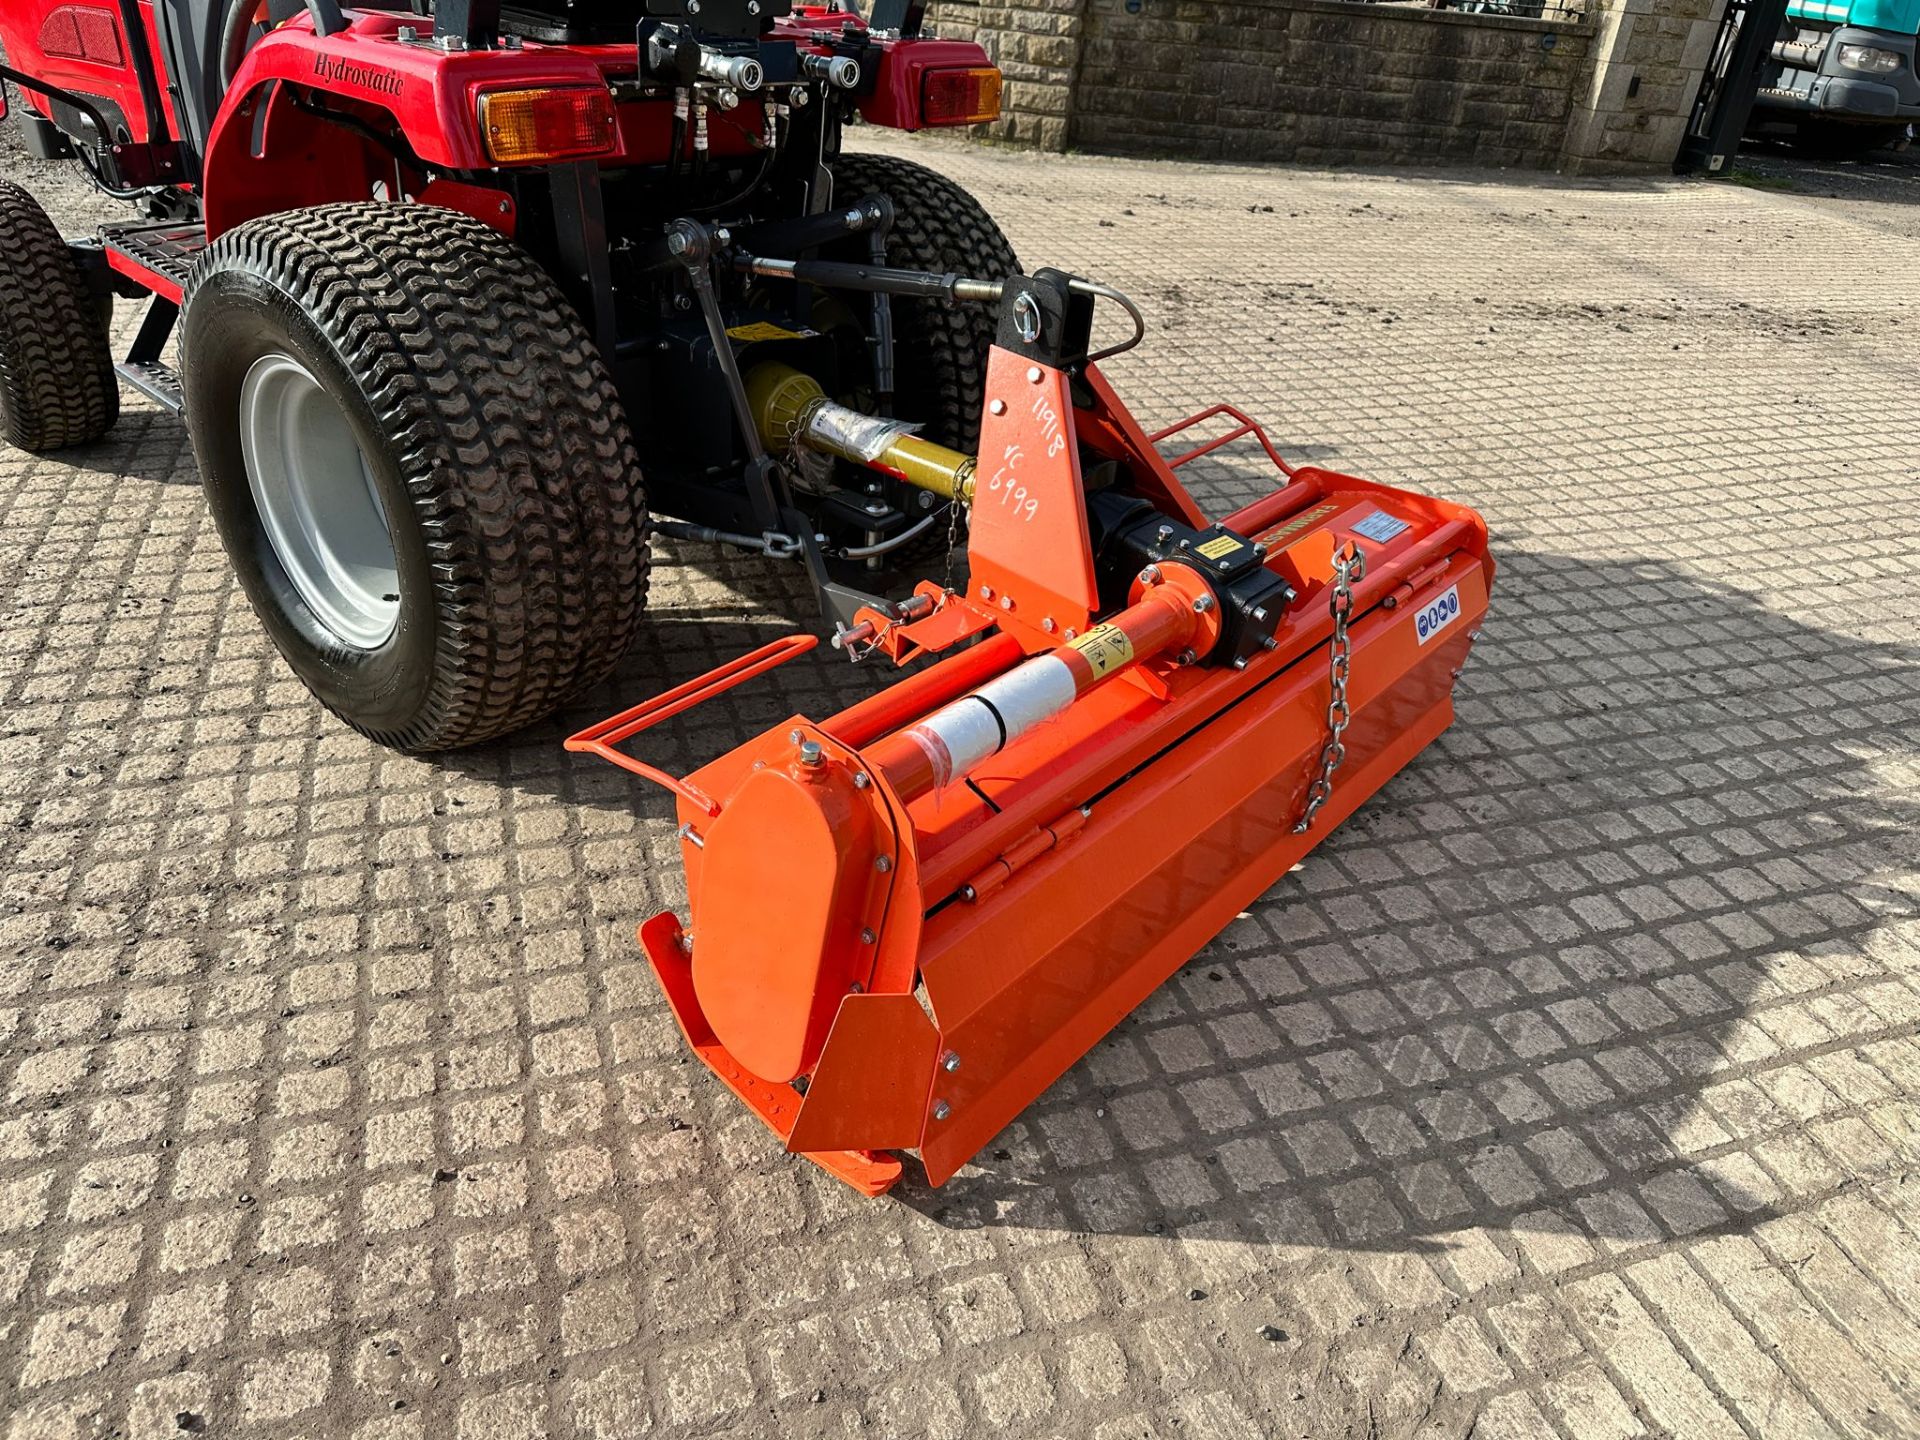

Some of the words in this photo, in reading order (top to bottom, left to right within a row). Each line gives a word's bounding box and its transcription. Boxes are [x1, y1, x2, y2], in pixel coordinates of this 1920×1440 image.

[313, 51, 404, 96] Hydrostatic
[1032, 396, 1065, 458] 11918
[989, 467, 1039, 522] 6999
